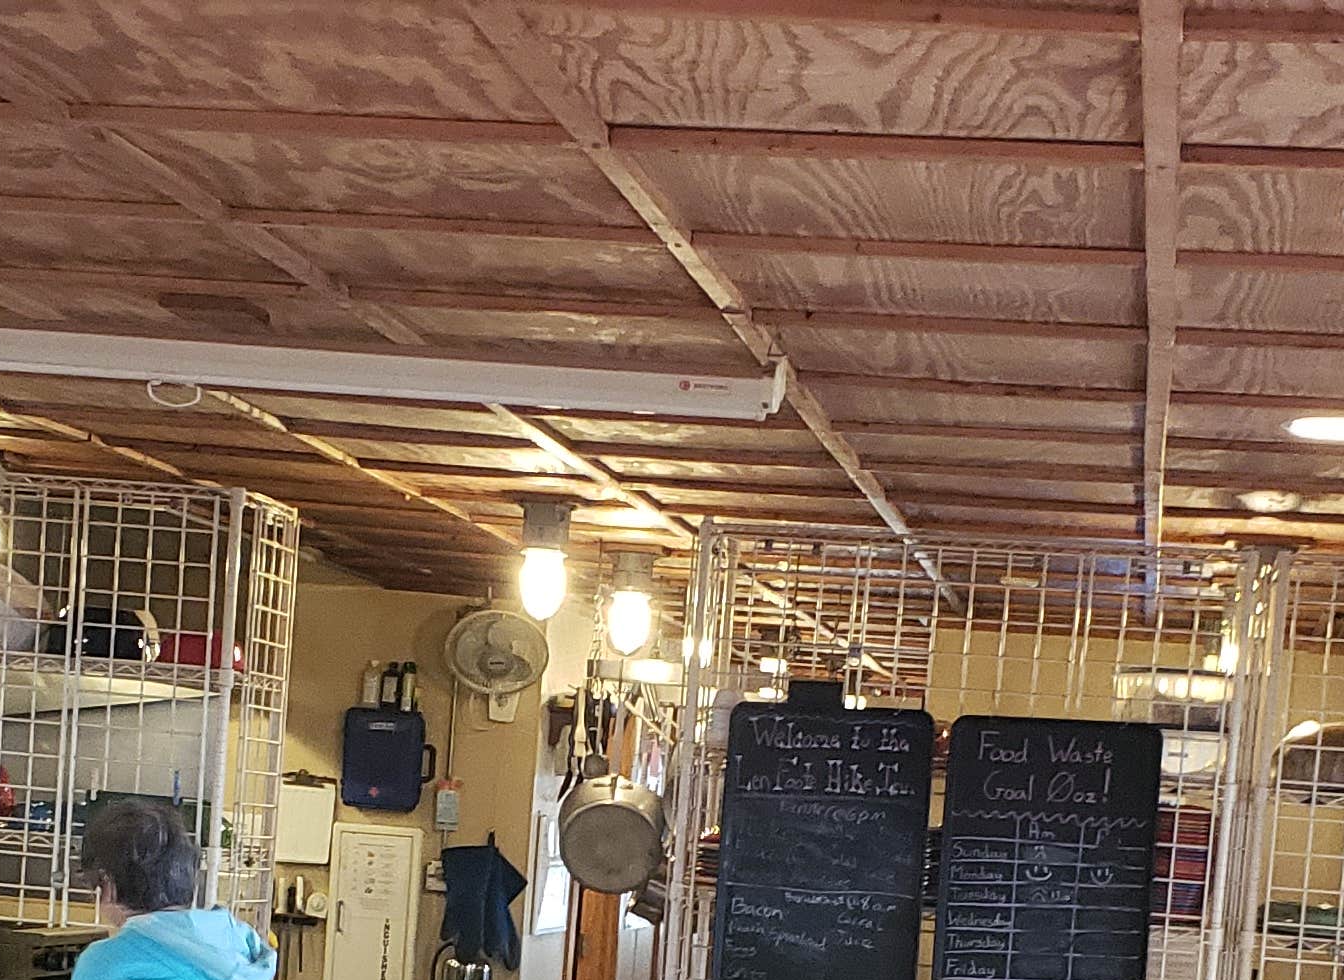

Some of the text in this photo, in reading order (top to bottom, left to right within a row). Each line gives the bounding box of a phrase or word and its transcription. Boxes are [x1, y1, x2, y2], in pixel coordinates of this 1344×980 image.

[749, 716, 840, 749] Welcome
[878, 728, 910, 752] the
[977, 730, 1115, 764] Food Waste
[735, 755, 770, 791] Len
[824, 759, 873, 794] Hike
[983, 769, 1035, 801] Goal
[952, 840, 1008, 860] Sunday
[949, 864, 1004, 883] Monday
[731, 896, 784, 919] Bacon
[947, 911, 1013, 928] Wednesday
[947, 933, 1006, 950] Thursday
[945, 958, 996, 979] Friday
